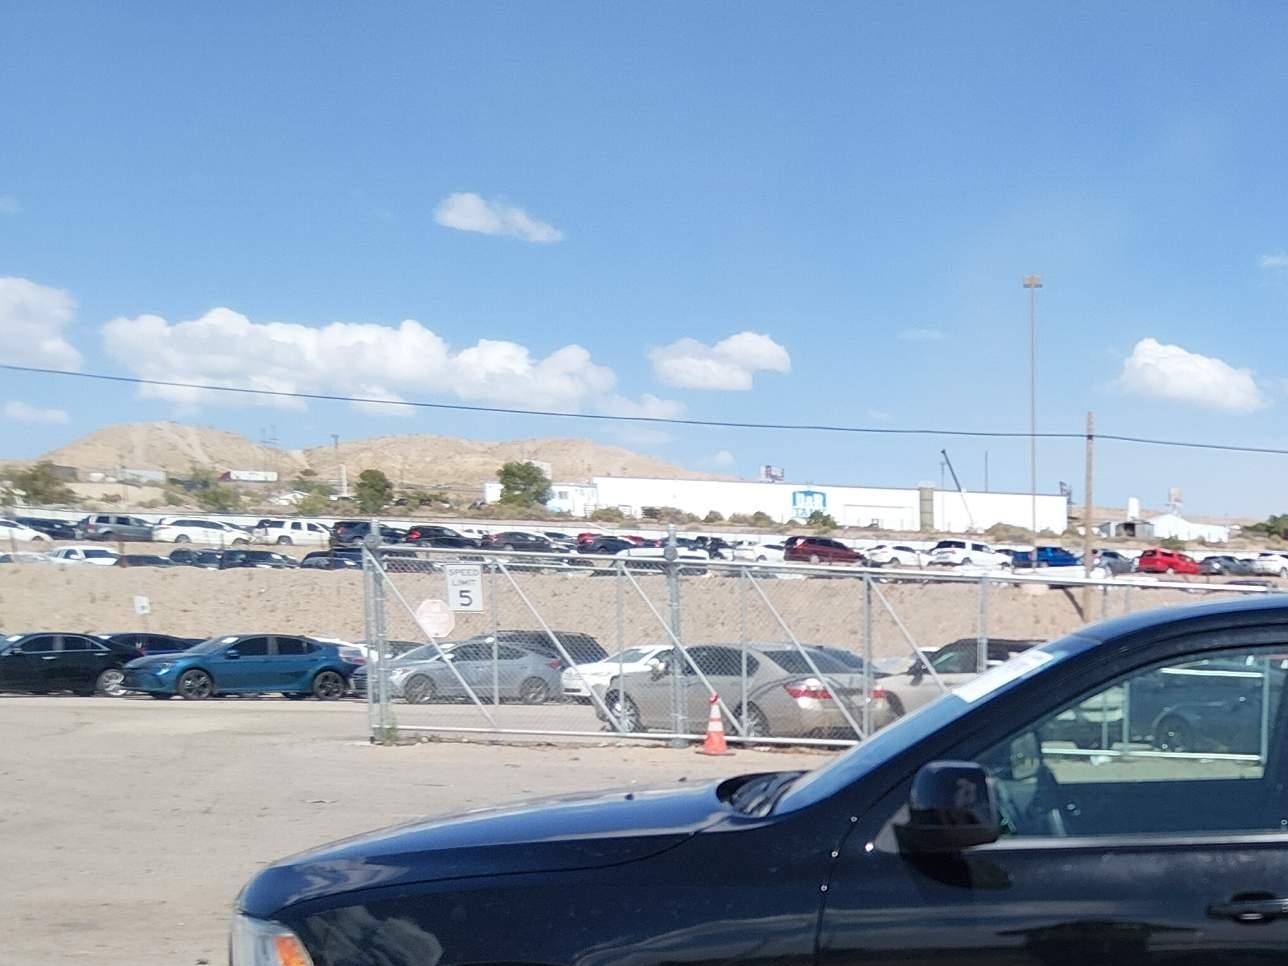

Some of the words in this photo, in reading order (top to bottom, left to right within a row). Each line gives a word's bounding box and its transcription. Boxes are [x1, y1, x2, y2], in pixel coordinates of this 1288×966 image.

[448, 568, 480, 576] SPEED
[451, 579, 477, 587] LIMIT
[459, 589, 473, 607] 5
